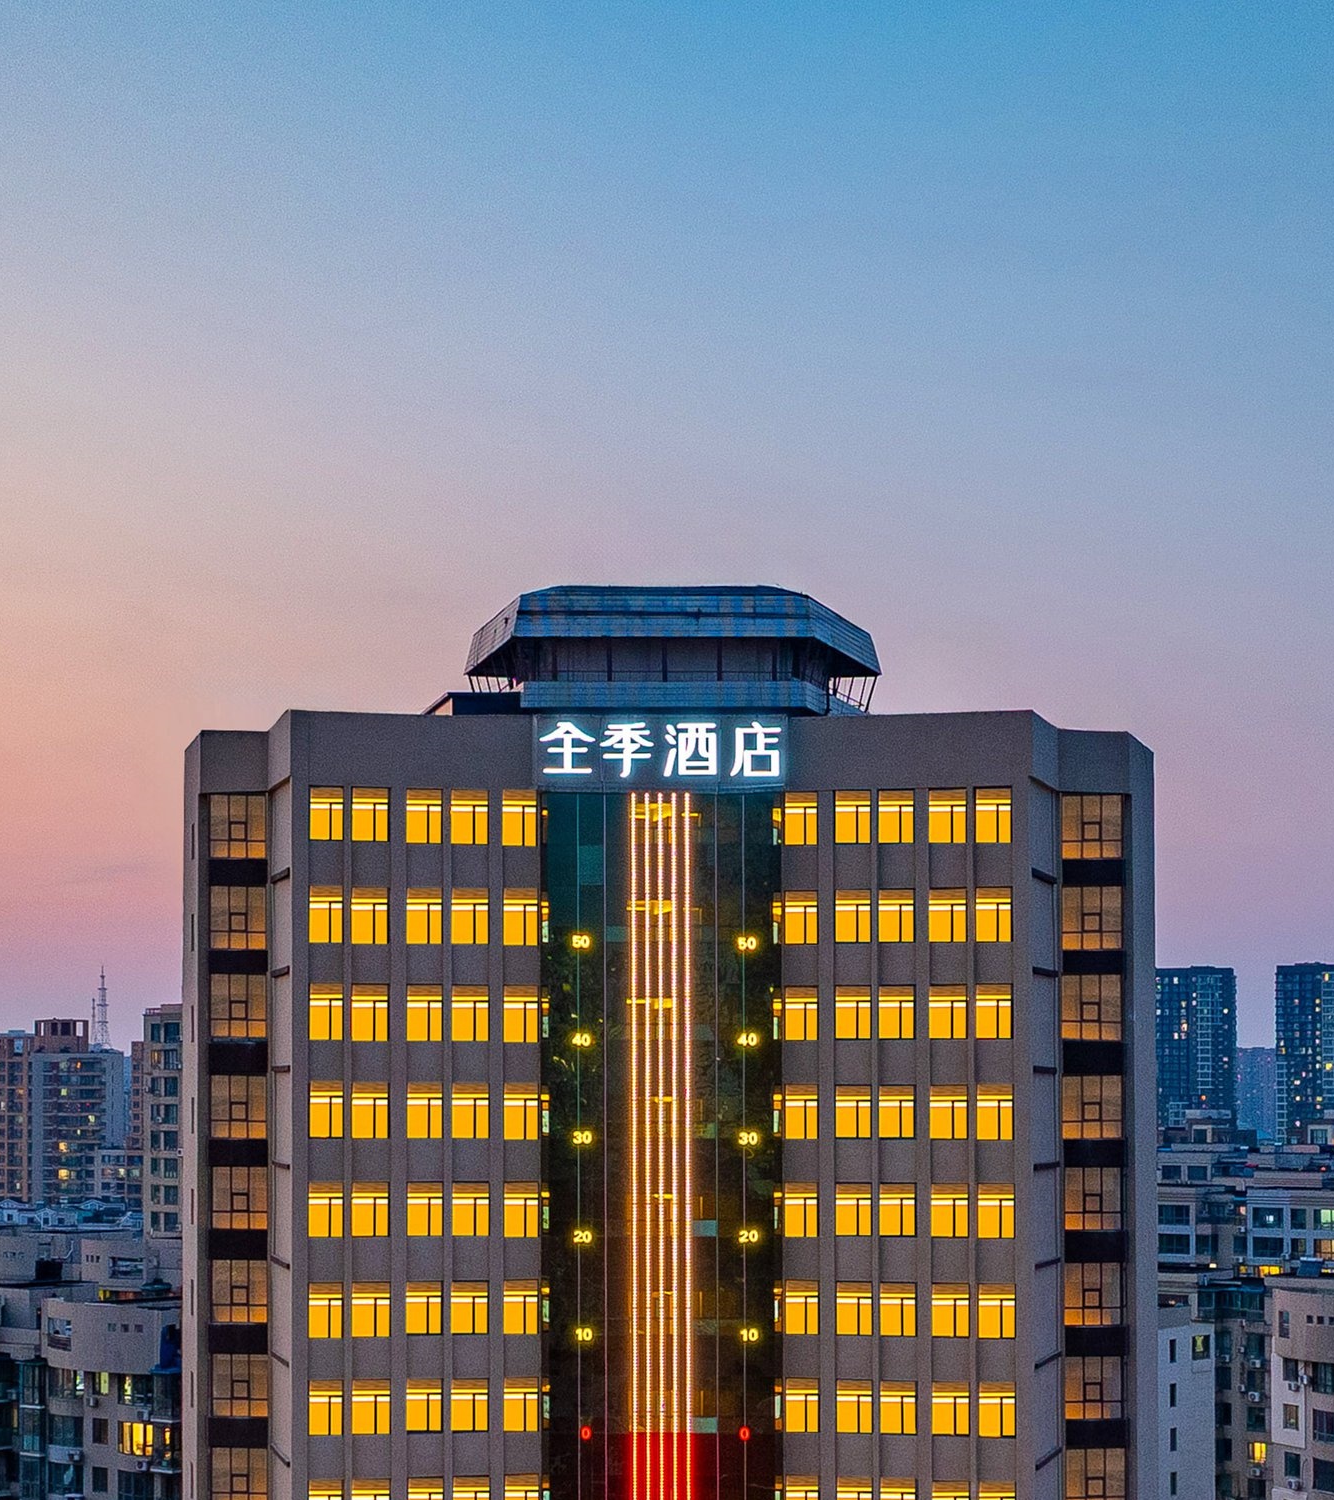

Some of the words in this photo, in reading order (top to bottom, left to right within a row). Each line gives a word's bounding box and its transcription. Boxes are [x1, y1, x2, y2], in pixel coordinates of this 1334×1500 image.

[539, 721, 782, 778] 全季酒店
[571, 932, 591, 949] 50
[737, 935, 758, 952] 50
[571, 1032, 592, 1047] 40
[737, 1032, 759, 1047] 40
[572, 1130, 593, 1145] 30
[738, 1131, 759, 1146] 30
[573, 1229, 593, 1244] 20
[738, 1229, 759, 1244] 20
[575, 1327, 593, 1341] 10
[739, 1327, 759, 1342] 10
[581, 1426, 592, 1440] 0
[739, 1426, 750, 1441] 0
